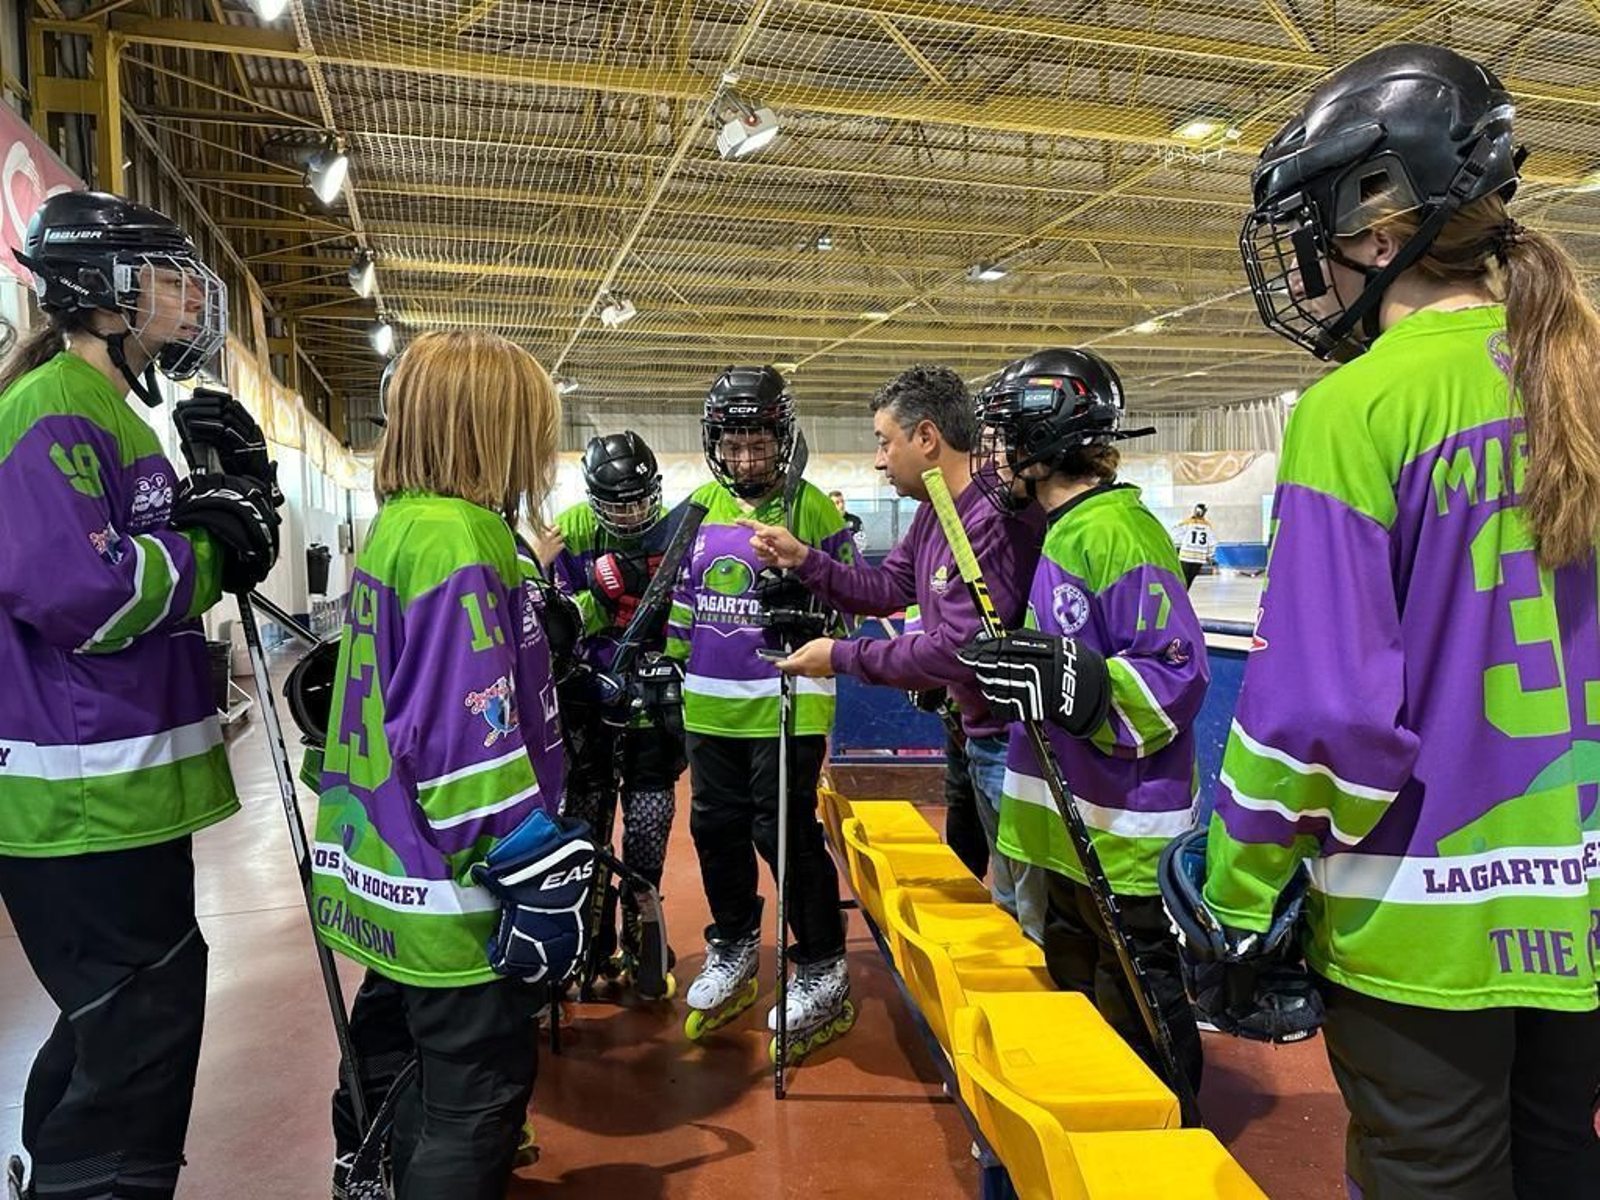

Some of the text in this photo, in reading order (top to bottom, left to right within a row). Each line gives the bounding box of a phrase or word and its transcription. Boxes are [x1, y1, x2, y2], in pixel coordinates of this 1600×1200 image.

[49, 231, 102, 240] BAUER
[1025, 393, 1050, 401] CCM
[728, 406, 758, 414] CCM
[1191, 531, 1207, 545] 13
[696, 594, 762, 614] LAGARTO
[1423, 857, 1588, 894] LAGARTO
[361, 873, 429, 906] HOCKEY
[1489, 928, 1579, 977] THE
